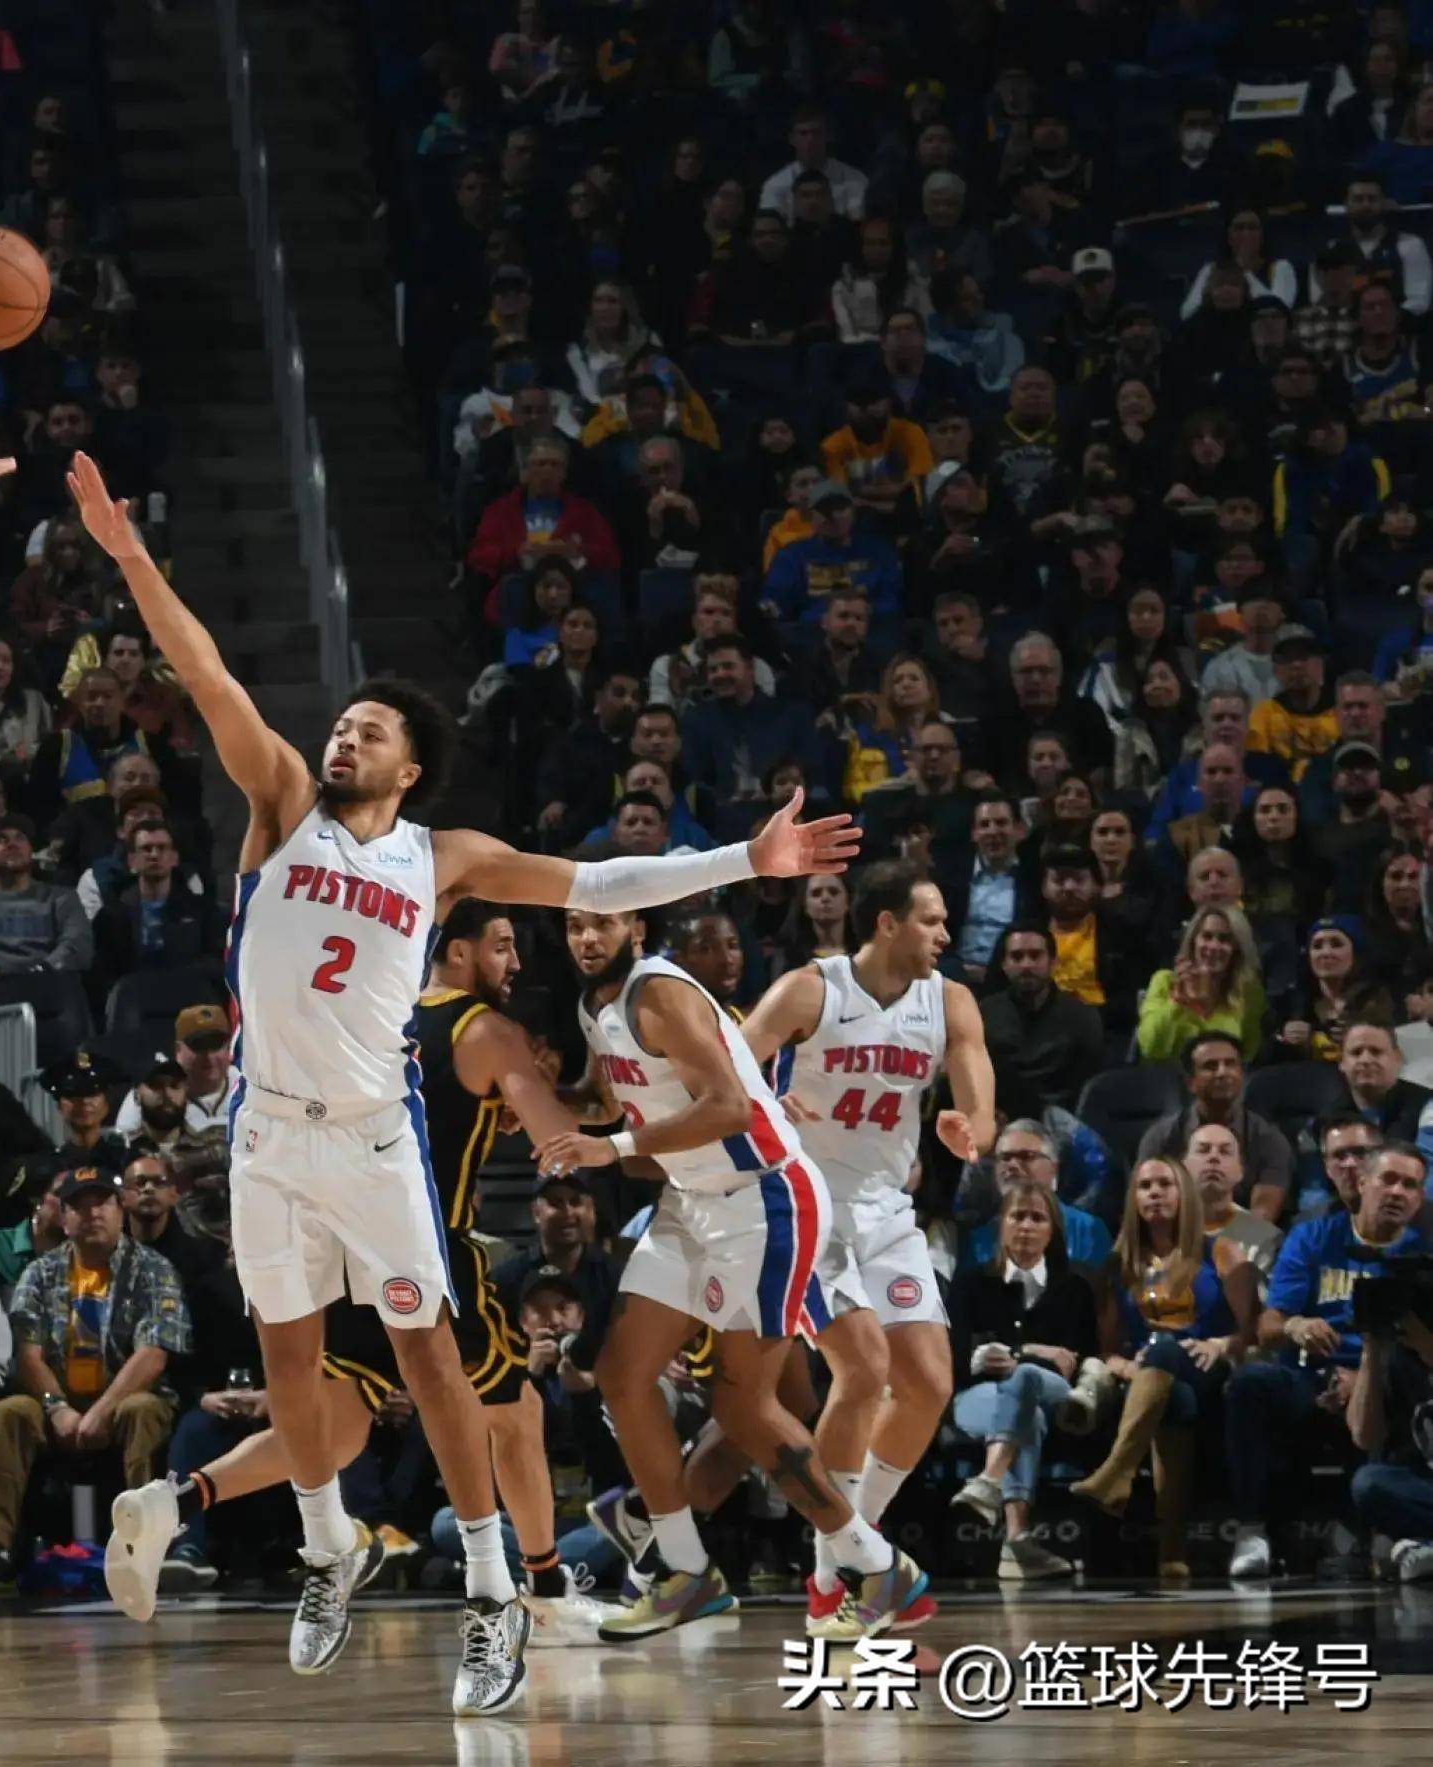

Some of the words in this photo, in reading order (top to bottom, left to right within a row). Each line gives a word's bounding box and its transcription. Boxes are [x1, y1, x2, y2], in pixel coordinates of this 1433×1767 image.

[284, 864, 421, 938] PISTONS
[311, 935, 356, 994] 2
[823, 1044, 933, 1080] PISTONS
[831, 1088, 901, 1131] 44
